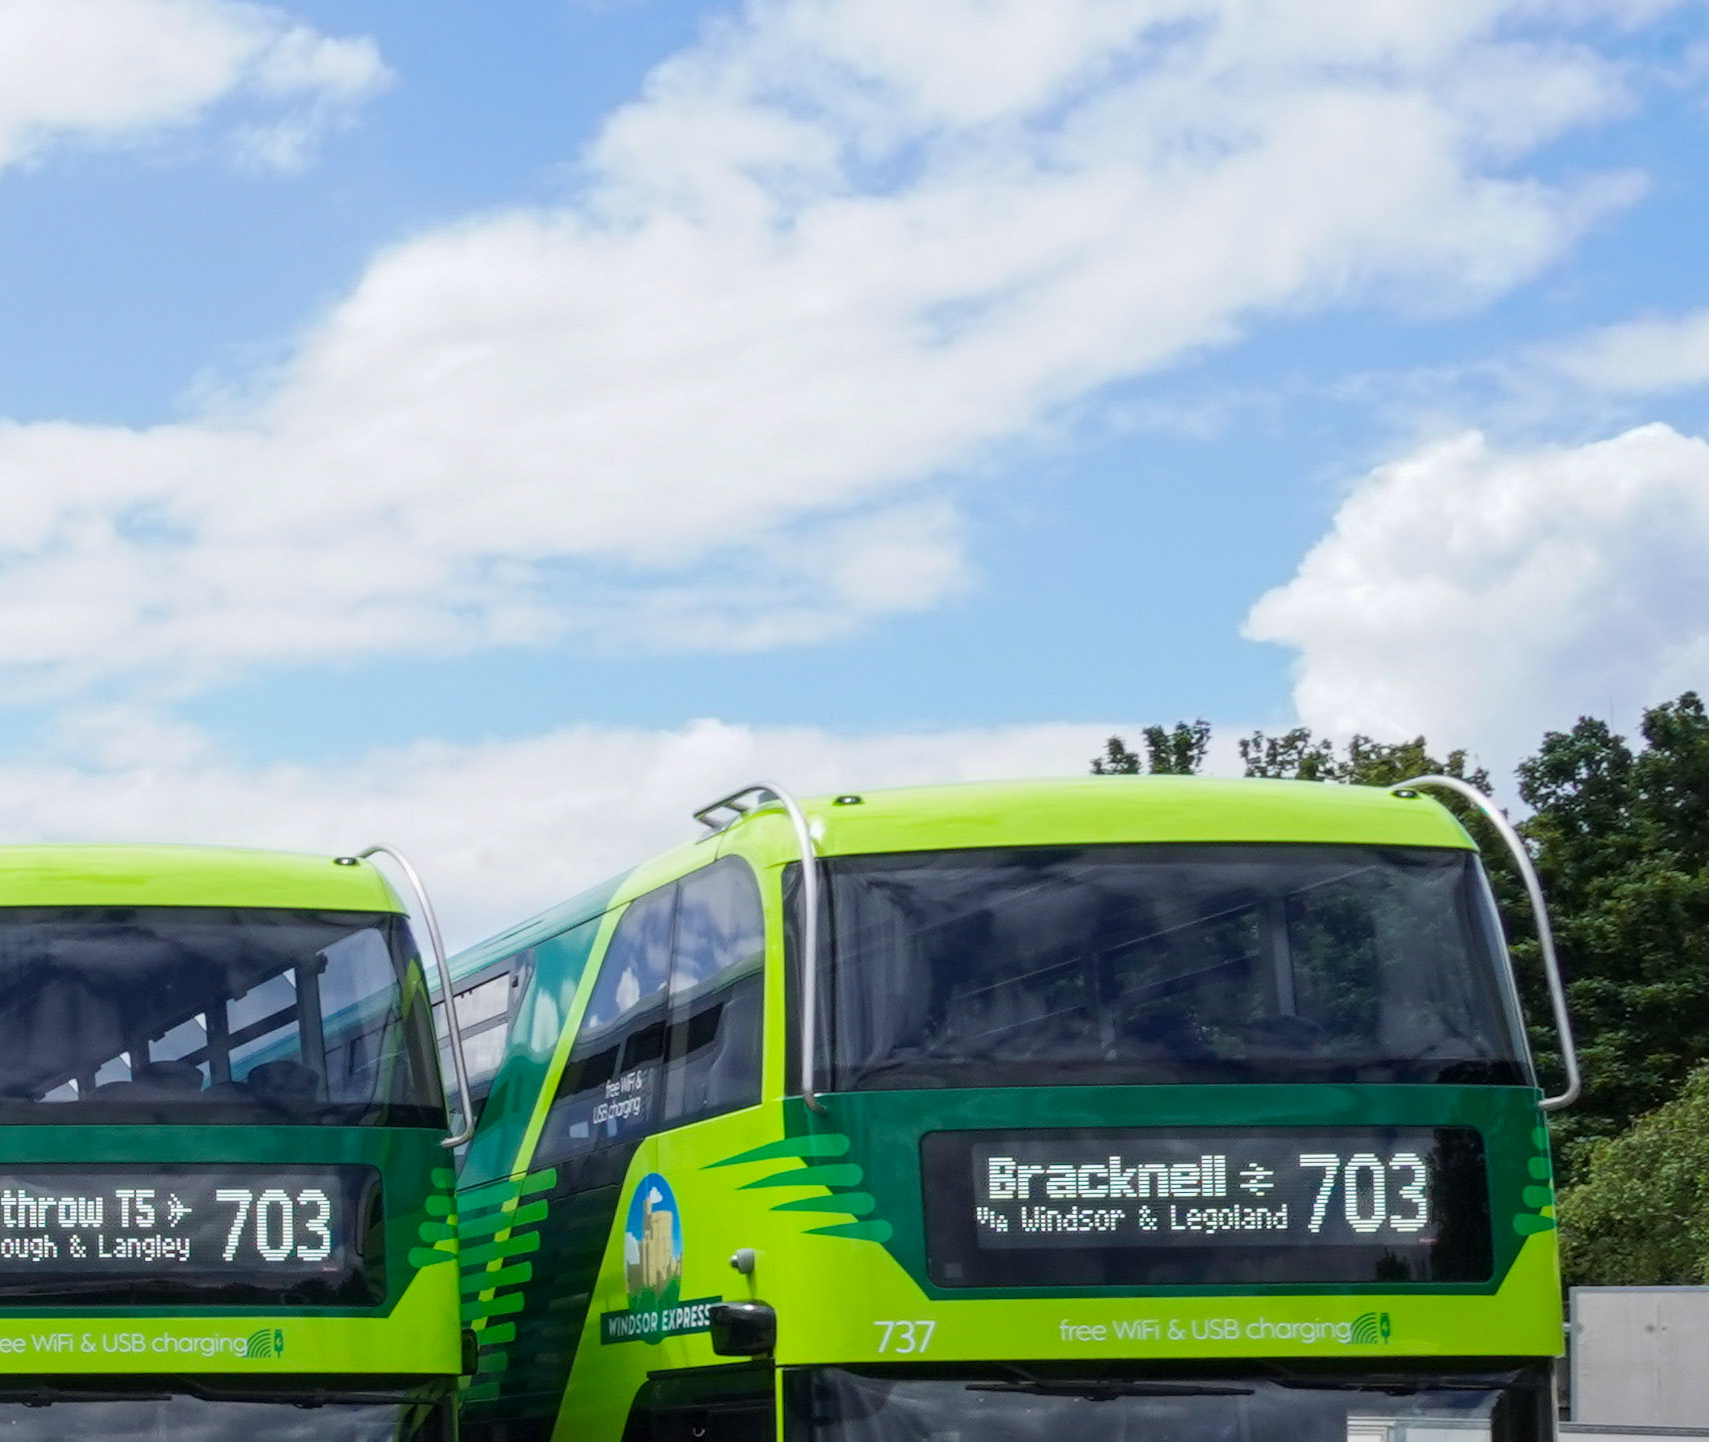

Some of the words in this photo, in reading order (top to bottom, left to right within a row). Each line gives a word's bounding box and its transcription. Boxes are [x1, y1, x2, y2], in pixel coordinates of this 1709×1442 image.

[987, 1155, 1228, 1200] Bracknell
[1298, 1152, 1429, 1234] 703
[115, 1189, 156, 1229] T5
[215, 1188, 332, 1263] 703
[1021, 1204, 1125, 1233] Windsor
[1138, 1204, 1159, 1232] &
[1170, 1202, 1288, 1234] Legoland
[69, 1235, 87, 1259] &
[98, 1235, 191, 1262] Langley
[608, 1311, 659, 1337] WINDSOR
[872, 1319, 937, 1354] 737
[1059, 1317, 1108, 1341] free
[1111, 1317, 1161, 1341] WiFi
[1167, 1317, 1187, 1341] &
[1191, 1317, 1240, 1341] USB
[1246, 1317, 1353, 1344] charging
[30, 1331, 74, 1354] WiFi
[80, 1331, 98, 1354] &
[102, 1331, 147, 1354] USB
[151, 1331, 249, 1357] charging
